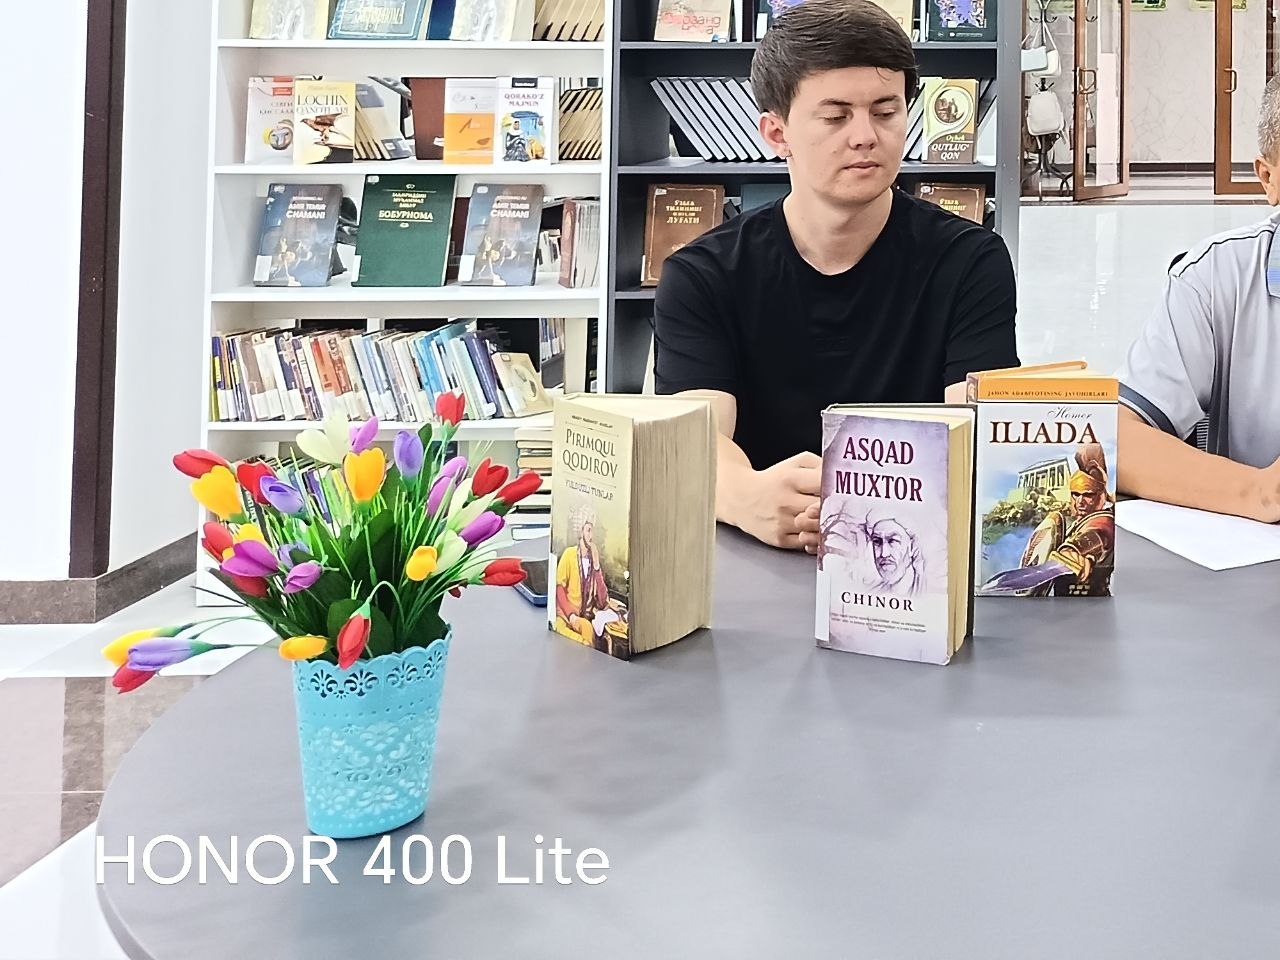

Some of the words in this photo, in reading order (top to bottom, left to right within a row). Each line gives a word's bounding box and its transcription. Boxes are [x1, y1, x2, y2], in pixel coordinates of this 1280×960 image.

[297, 94, 348, 106] LOCHIN
[940, 151, 960, 161] QON
[286, 210, 326, 219] CHAMANI
[378, 210, 434, 220] БОБУРНОМА
[1047, 405, 1093, 419] Homer
[989, 420, 1101, 444] ILIADA
[566, 428, 616, 458] PIRIMQUL
[842, 436, 914, 467] ASQAD
[562, 449, 618, 479] QODIROV
[835, 470, 923, 503] MUXTOR
[841, 591, 914, 612] CHINOR
